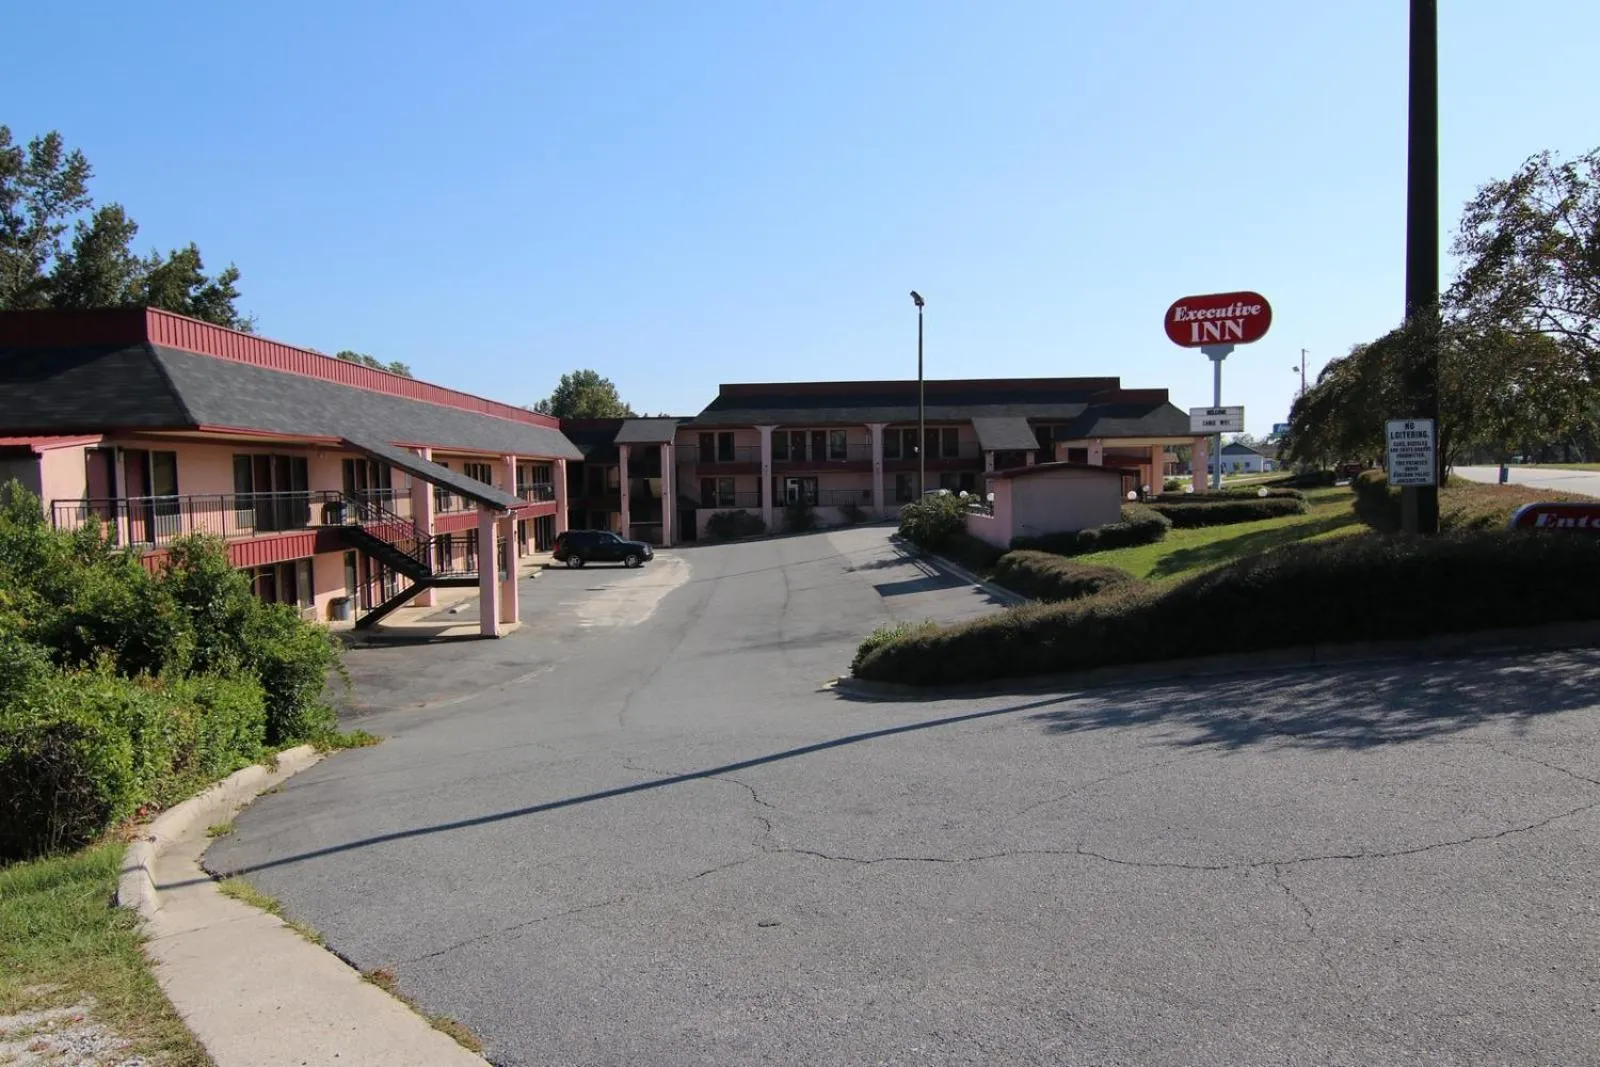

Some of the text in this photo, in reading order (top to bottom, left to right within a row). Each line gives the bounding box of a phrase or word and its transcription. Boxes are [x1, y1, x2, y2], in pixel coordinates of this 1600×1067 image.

[1174, 302, 1261, 322] Executive
[1191, 319, 1245, 342] INN
[1405, 422, 1415, 430] NO
